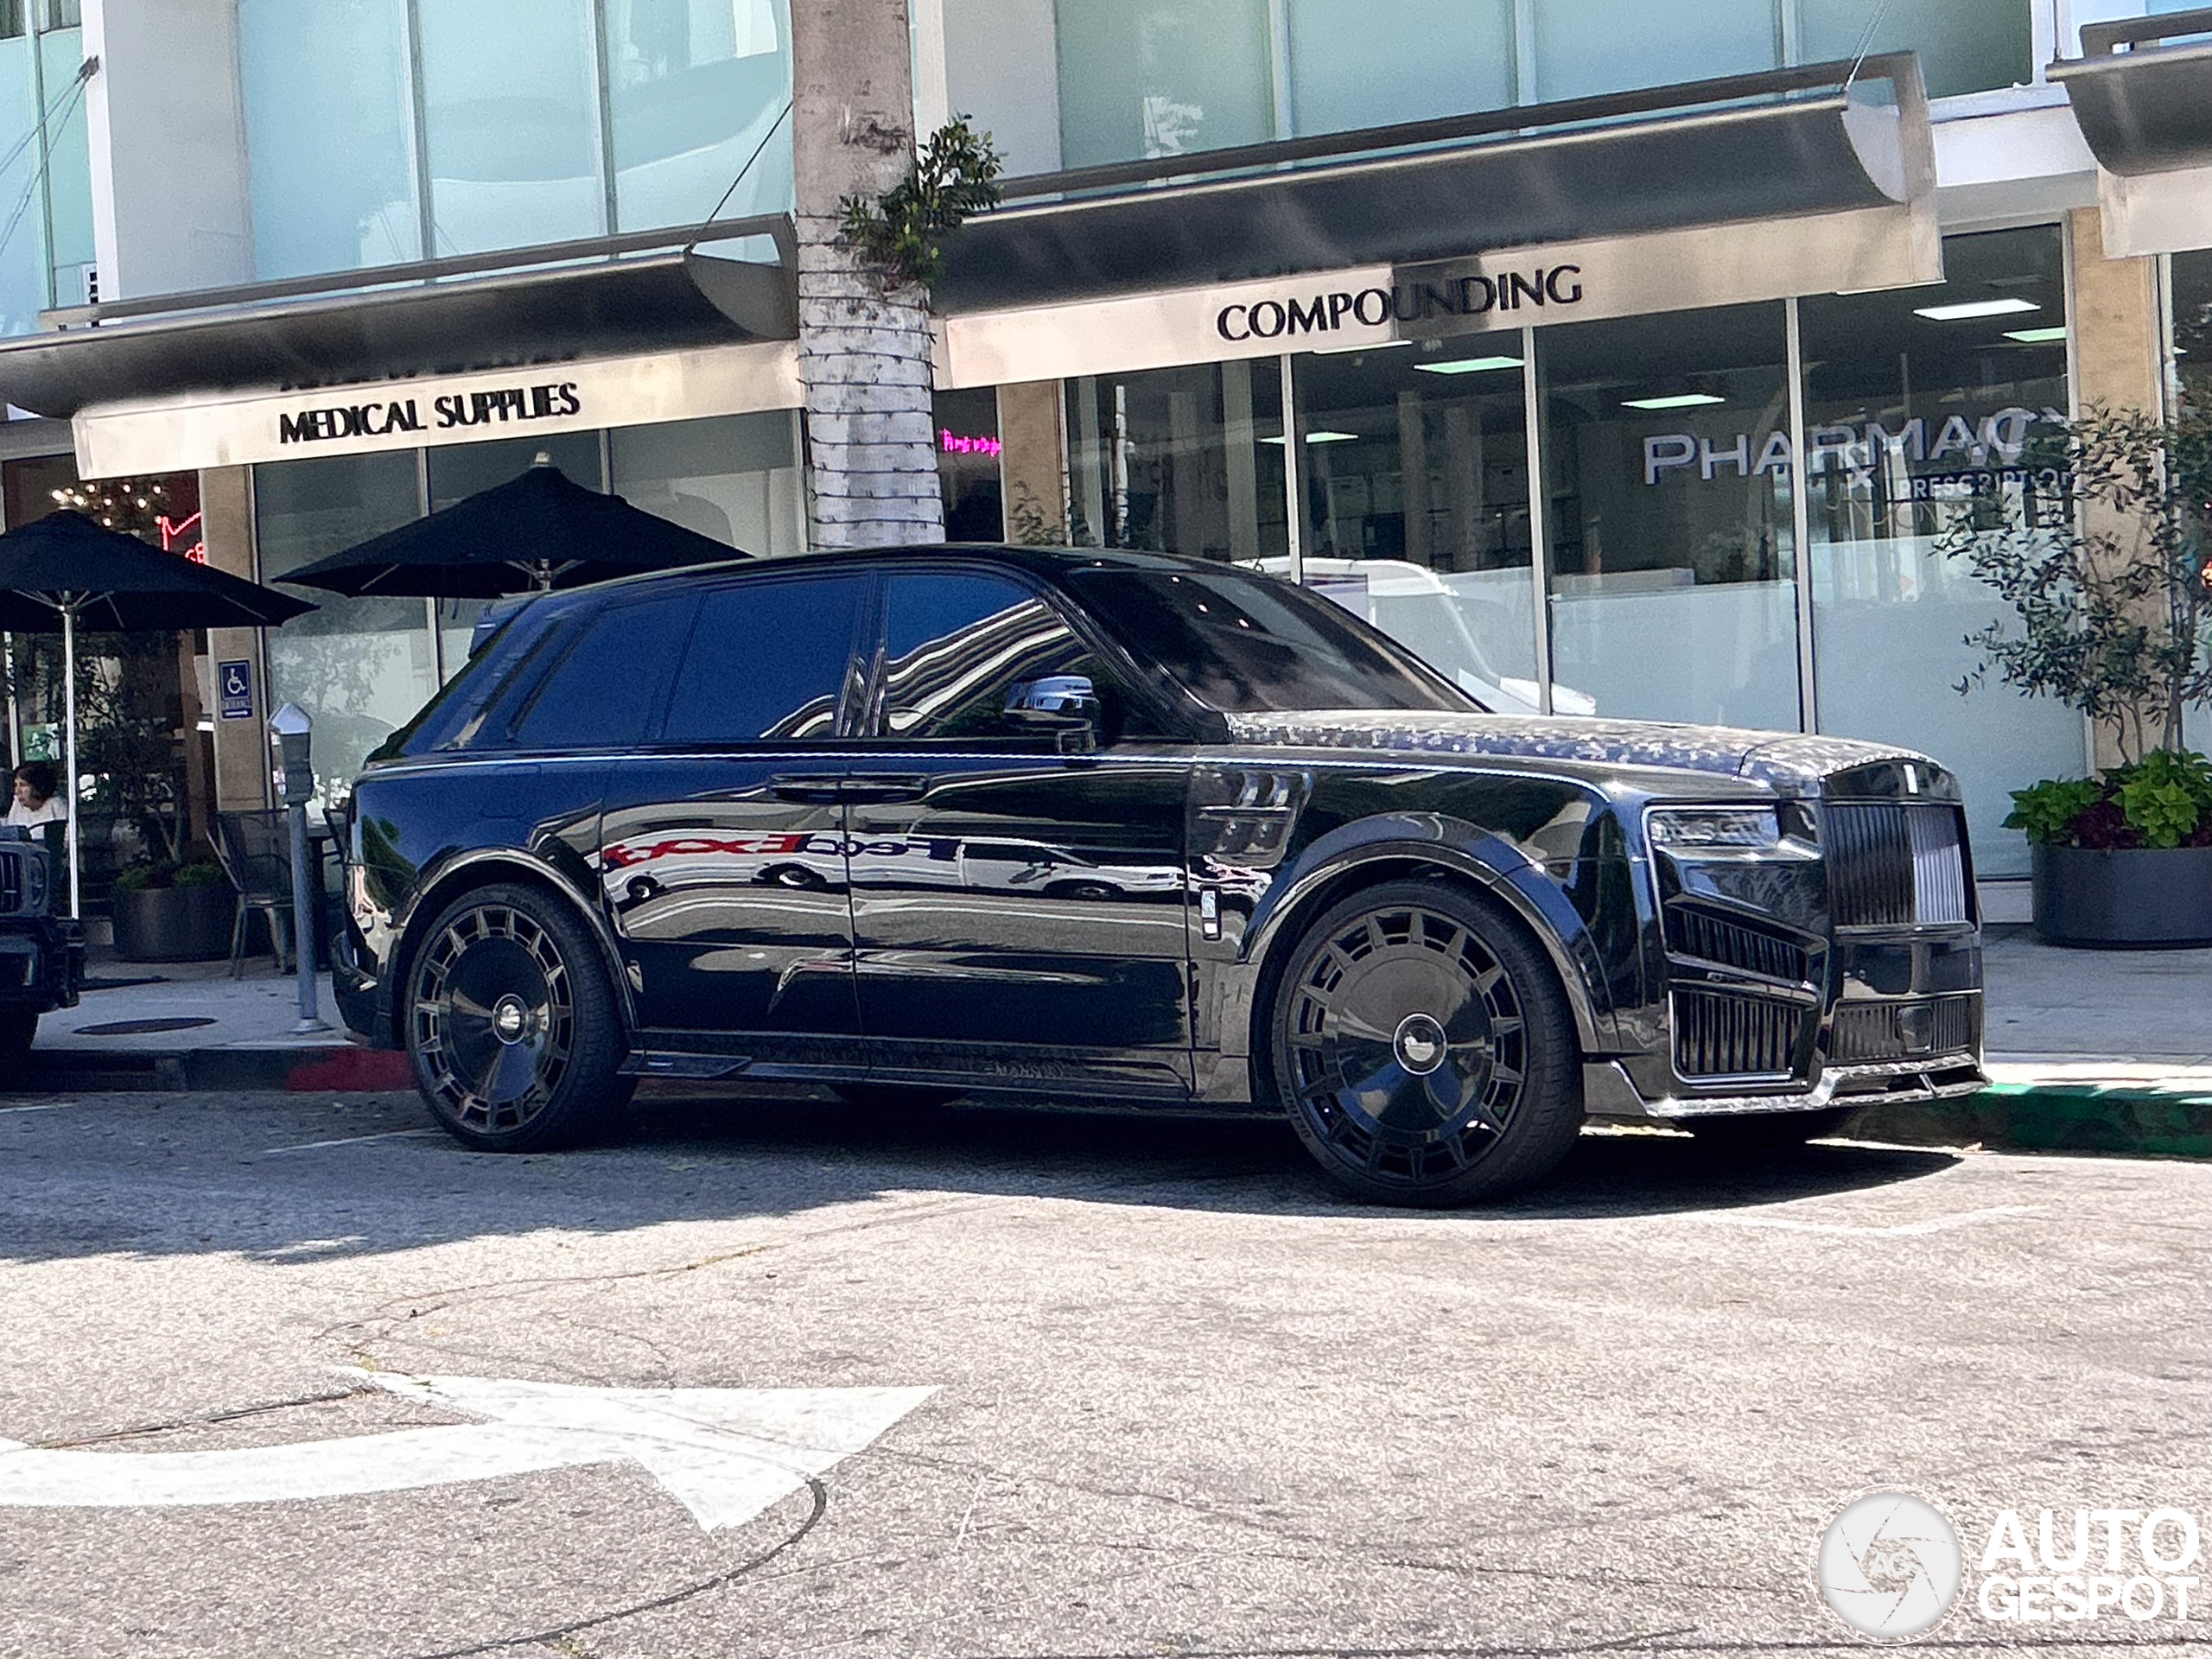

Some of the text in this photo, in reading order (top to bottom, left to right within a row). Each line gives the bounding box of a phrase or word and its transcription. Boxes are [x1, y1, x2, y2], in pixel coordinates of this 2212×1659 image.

[1217, 264, 1582, 341] COMPOUNDING
[280, 383, 581, 444] MEDICAL SUPPLIES
[1644, 407, 2073, 486] PHARMAC
